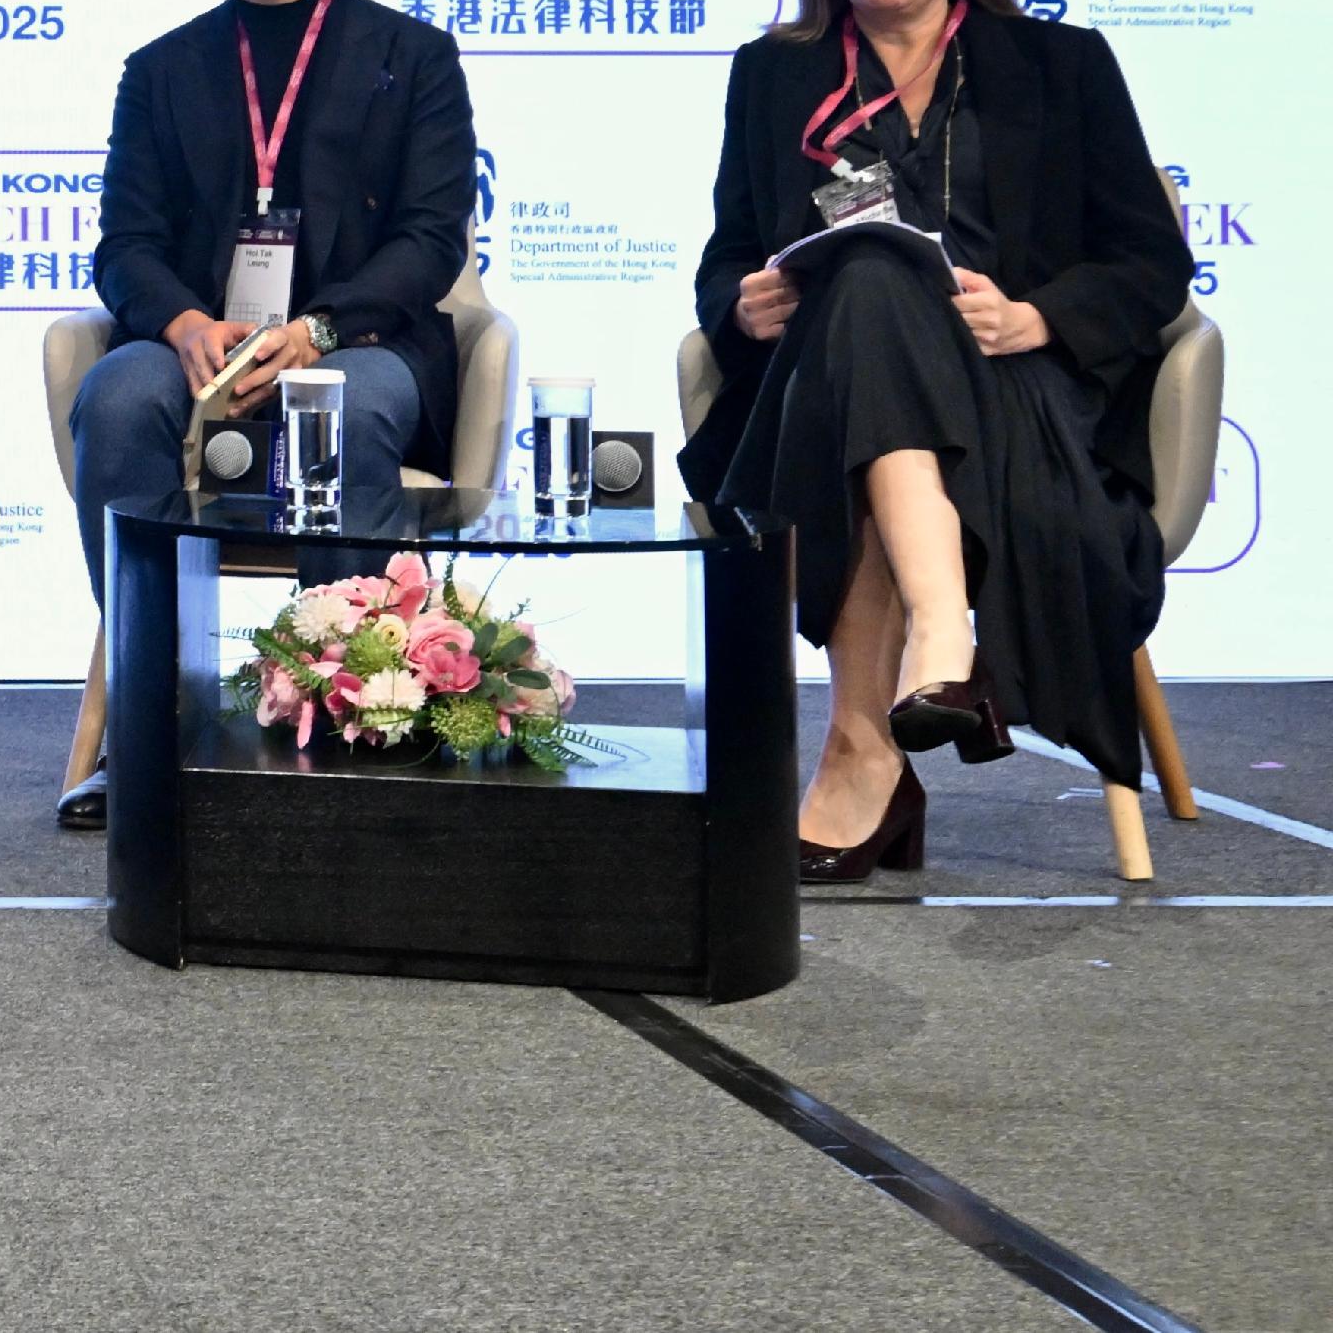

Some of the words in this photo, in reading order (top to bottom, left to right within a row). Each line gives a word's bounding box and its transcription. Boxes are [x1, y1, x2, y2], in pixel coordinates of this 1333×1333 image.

[511, 202, 569, 218] 律政司
[1180, 204, 1259, 245] EK
[511, 239, 599, 256] Department
[604, 239, 621, 252] of
[626, 239, 676, 252] Justice
